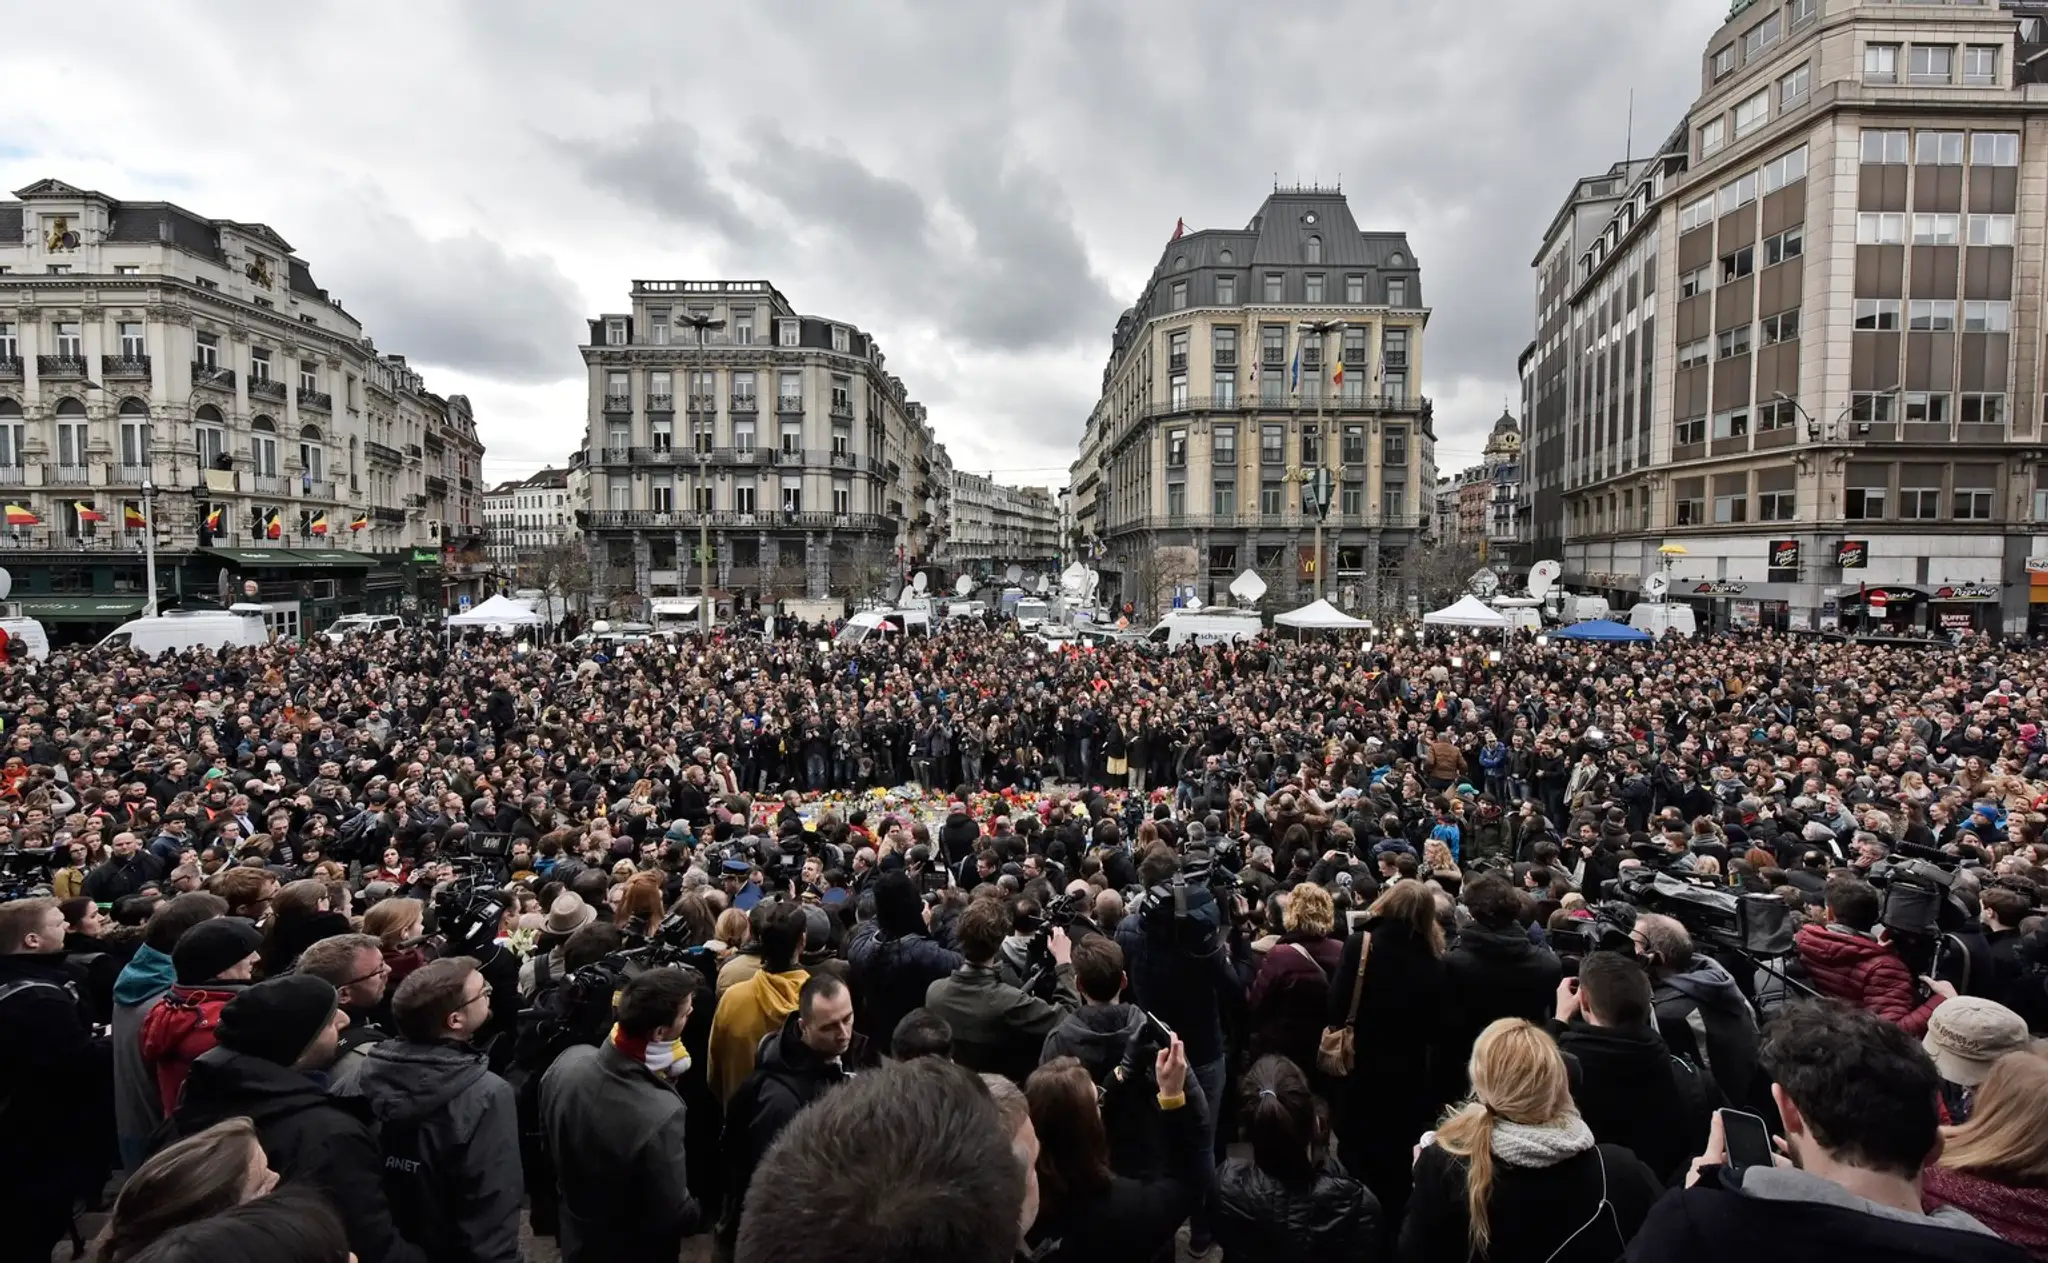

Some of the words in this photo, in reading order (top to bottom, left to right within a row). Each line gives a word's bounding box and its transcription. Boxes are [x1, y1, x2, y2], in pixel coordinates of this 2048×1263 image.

[1775, 549, 1796, 562] Pizza
[1838, 549, 1861, 563] Pizza
[1710, 583, 1729, 592] Pizza
[1730, 584, 1746, 592] Hut
[1952, 587, 1977, 597] Pizza
[1978, 586, 1998, 596] Hut
